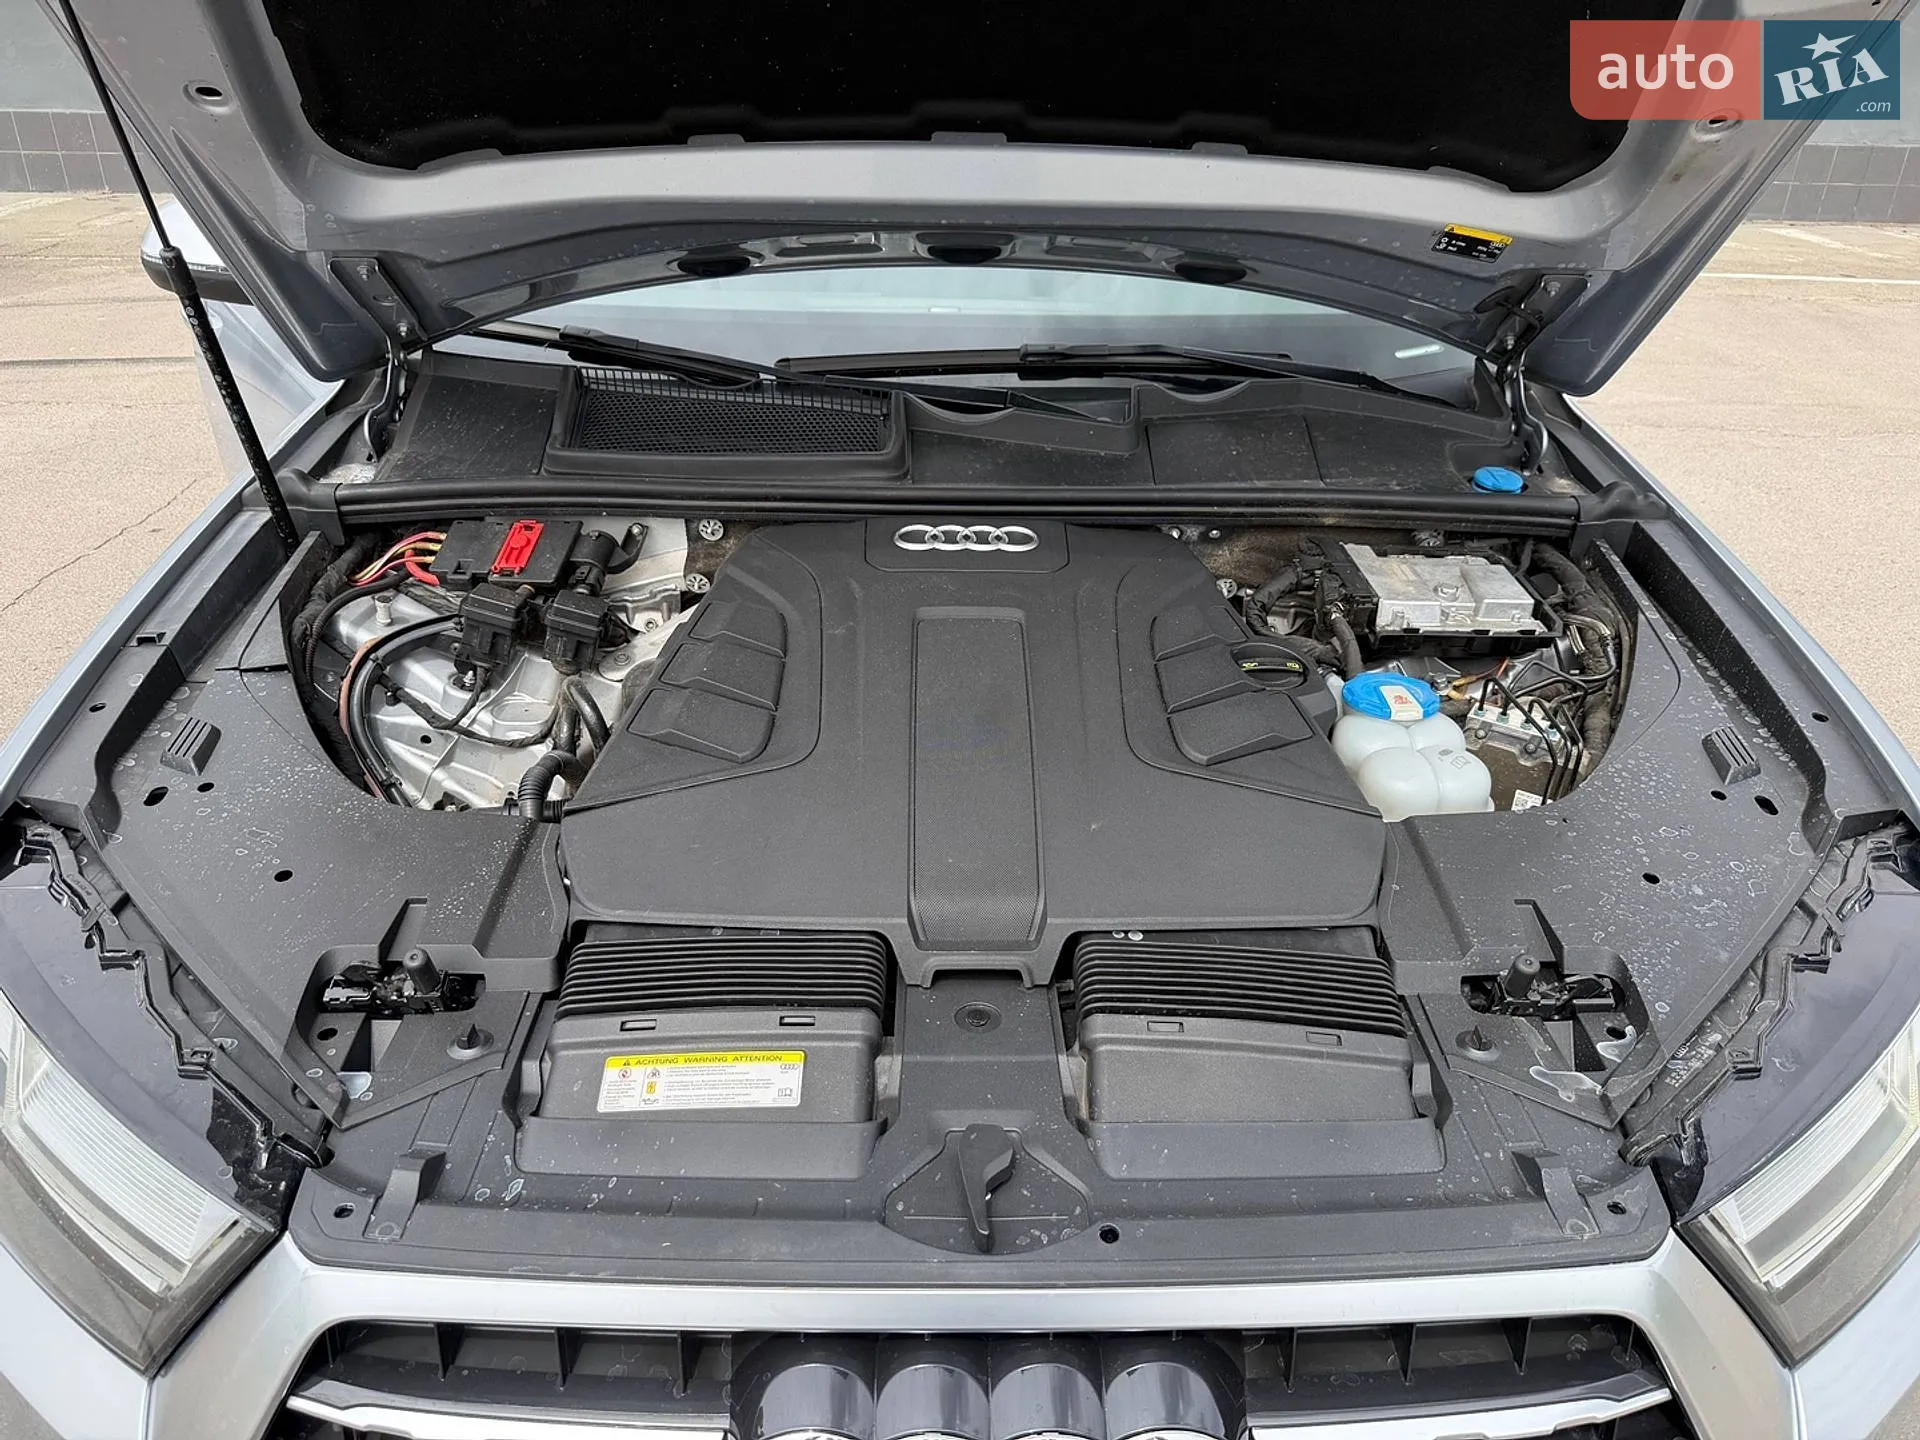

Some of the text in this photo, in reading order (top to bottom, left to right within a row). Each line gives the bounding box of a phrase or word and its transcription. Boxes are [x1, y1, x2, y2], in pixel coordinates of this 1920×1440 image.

[635, 1055, 783, 1065] ACHTUNG WARNING ATTENTION
